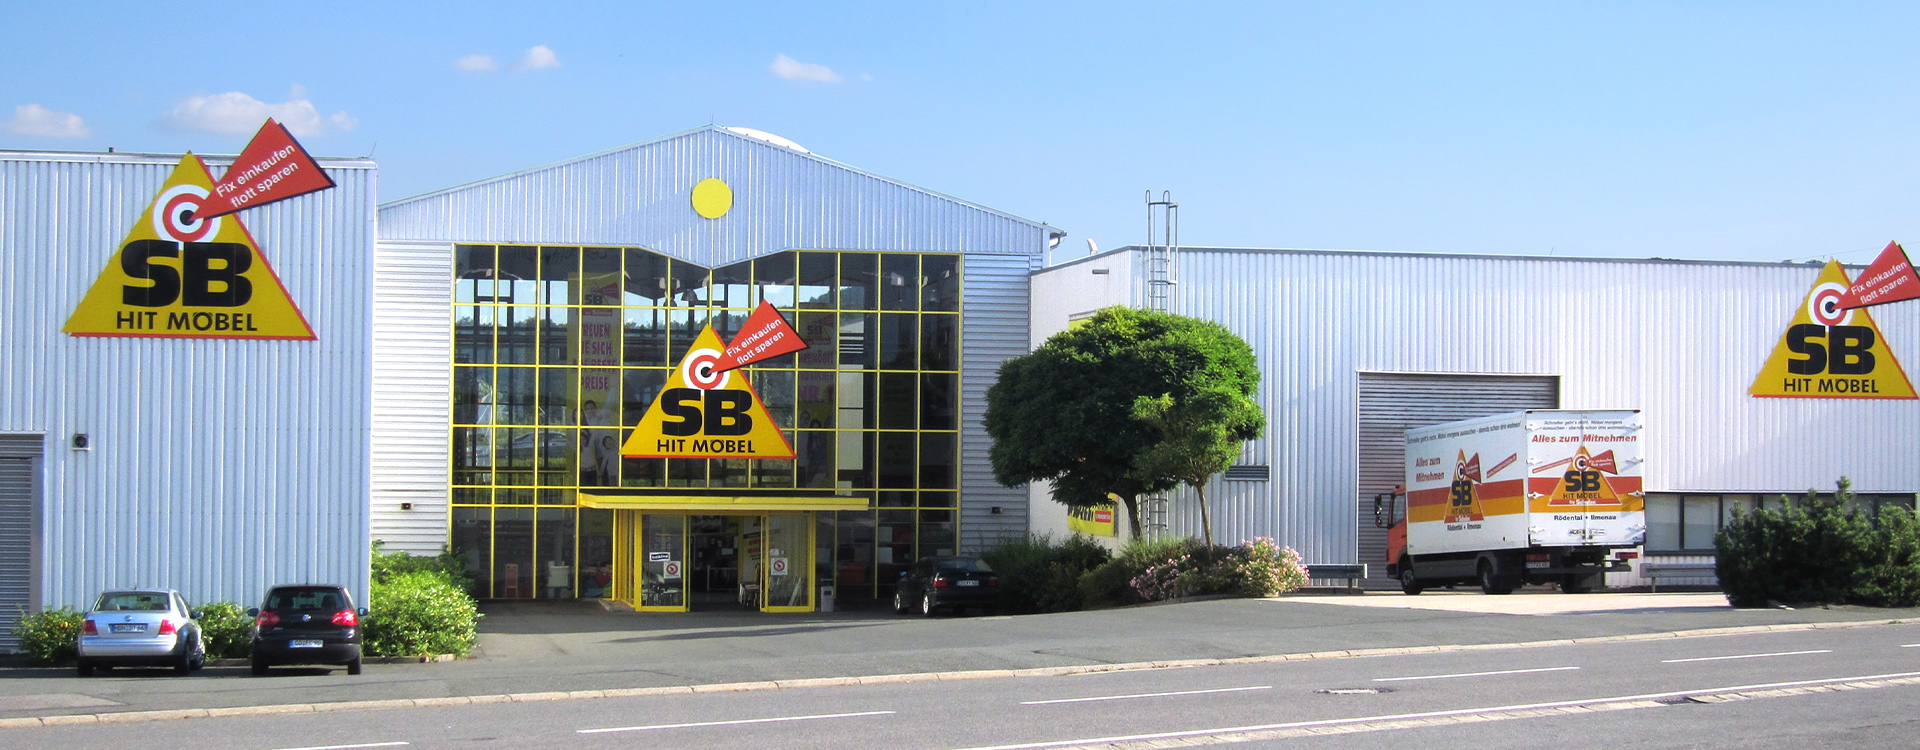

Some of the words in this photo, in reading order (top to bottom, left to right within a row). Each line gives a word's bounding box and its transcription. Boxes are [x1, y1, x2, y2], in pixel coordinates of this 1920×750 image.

[215, 181, 237, 198] Fix
[237, 143, 295, 185] einkaufen
[230, 187, 257, 208] flott
[257, 161, 299, 194] sparen
[120, 239, 253, 307] SB
[1850, 284, 1865, 296] Fix
[1865, 261, 1907, 287] einkaufen
[585, 294, 603, 305] SB
[1859, 288, 1878, 304] flott
[1878, 274, 1907, 296] sparen
[116, 311, 158, 330] HIT
[167, 311, 257, 331] MÖBEL
[583, 323, 610, 338] REUEN
[592, 341, 612, 355] SICH
[726, 345, 741, 358] Fix
[741, 318, 782, 349] einkaufen
[736, 349, 755, 365] flott
[755, 331, 785, 354] sparen
[1787, 324, 1875, 375] SB
[1784, 378, 1812, 392] HIT
[1818, 378, 1879, 393] MÖBEL
[660, 387, 753, 436] SB
[657, 439, 686, 452] HIT
[692, 439, 755, 453] MÖBEL
[1532, 434, 1556, 443] Alles
[1559, 435, 1580, 443] zum
[1582, 433, 1637, 442] Mitnehmen
[1416, 457, 1428, 468] Alles
[1429, 457, 1441, 466] zum
[1416, 471, 1445, 482] Mitnehmen
[1565, 471, 1600, 492] SB
[1452, 480, 1472, 506] SB
